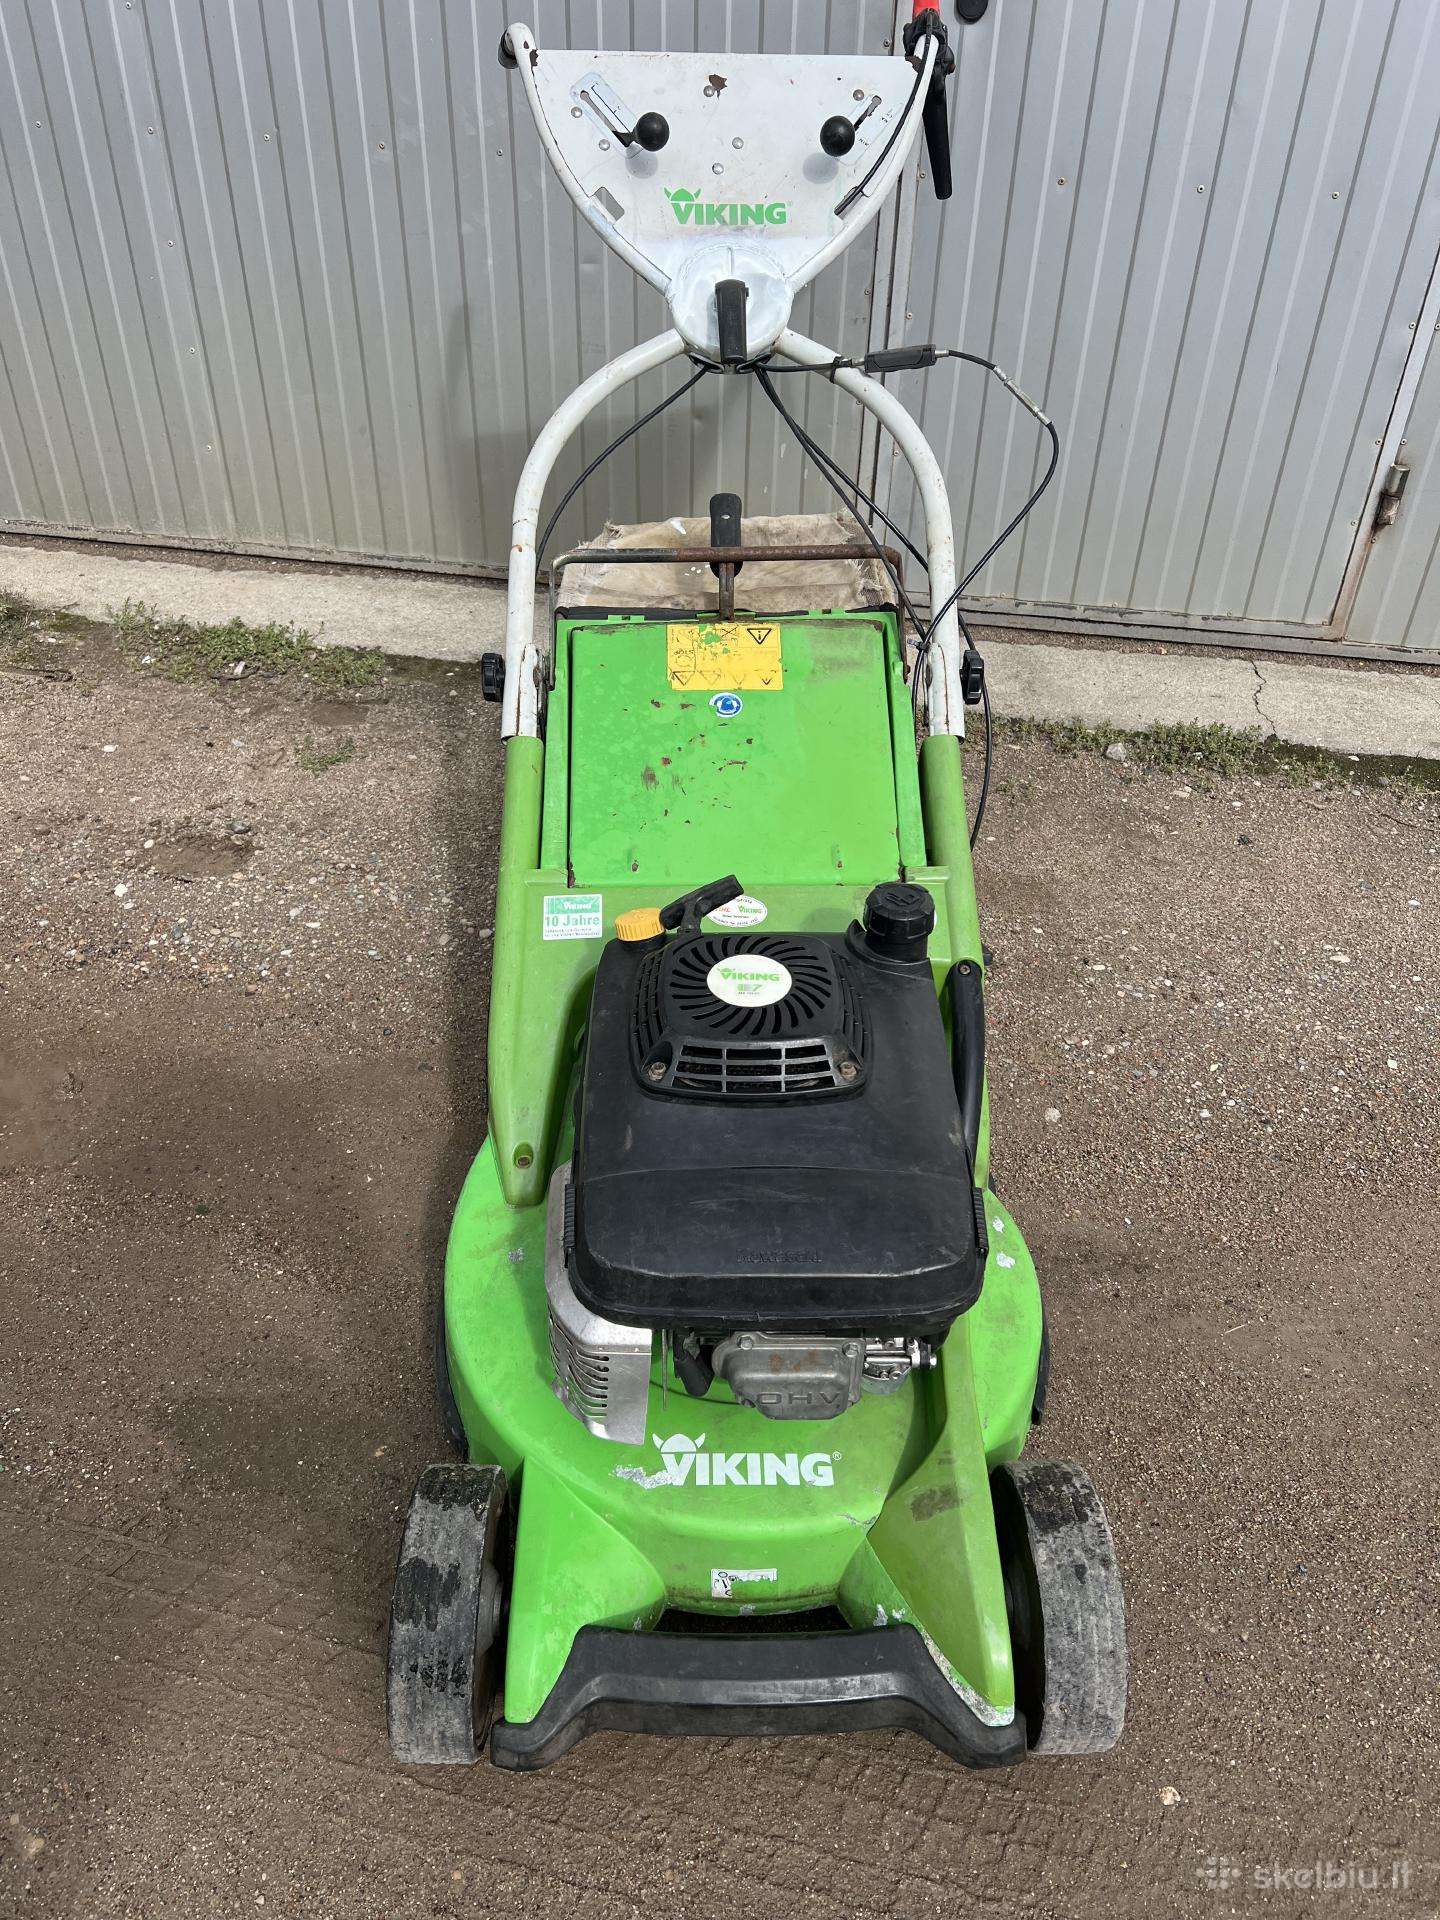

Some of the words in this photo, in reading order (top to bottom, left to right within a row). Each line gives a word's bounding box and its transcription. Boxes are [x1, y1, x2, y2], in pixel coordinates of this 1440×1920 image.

[670, 202, 787, 225] VIKING
[545, 915, 559, 927] 10
[563, 914, 600, 927] Jahre
[720, 972, 780, 982] VIKING
[757, 1391, 840, 1405] OHV
[660, 1452, 835, 1487] VIKING
